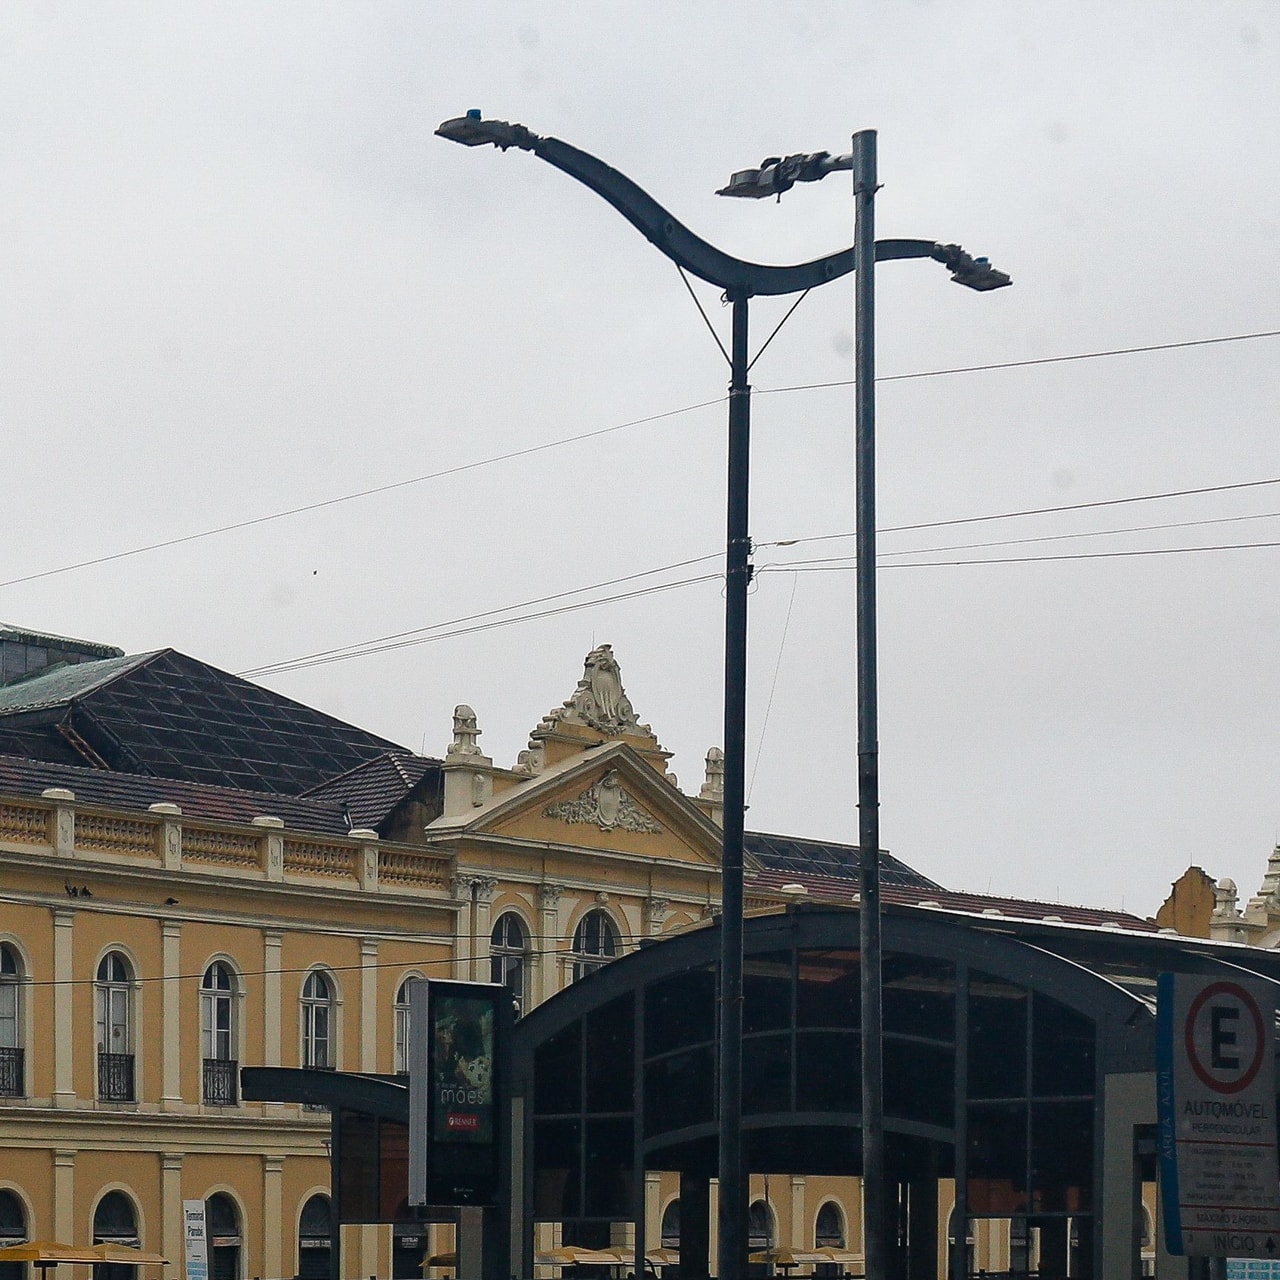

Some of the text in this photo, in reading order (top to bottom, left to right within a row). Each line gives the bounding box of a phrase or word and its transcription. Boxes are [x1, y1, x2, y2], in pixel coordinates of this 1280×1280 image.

[1211, 1006, 1240, 1069] E
[1184, 1098, 1268, 1120] AUTOMÓVEL
[454, 1117, 477, 1127] RENNER
[1239, 1213, 1268, 1226] HORAS
[1213, 1232, 1255, 1252] INÍCIO
